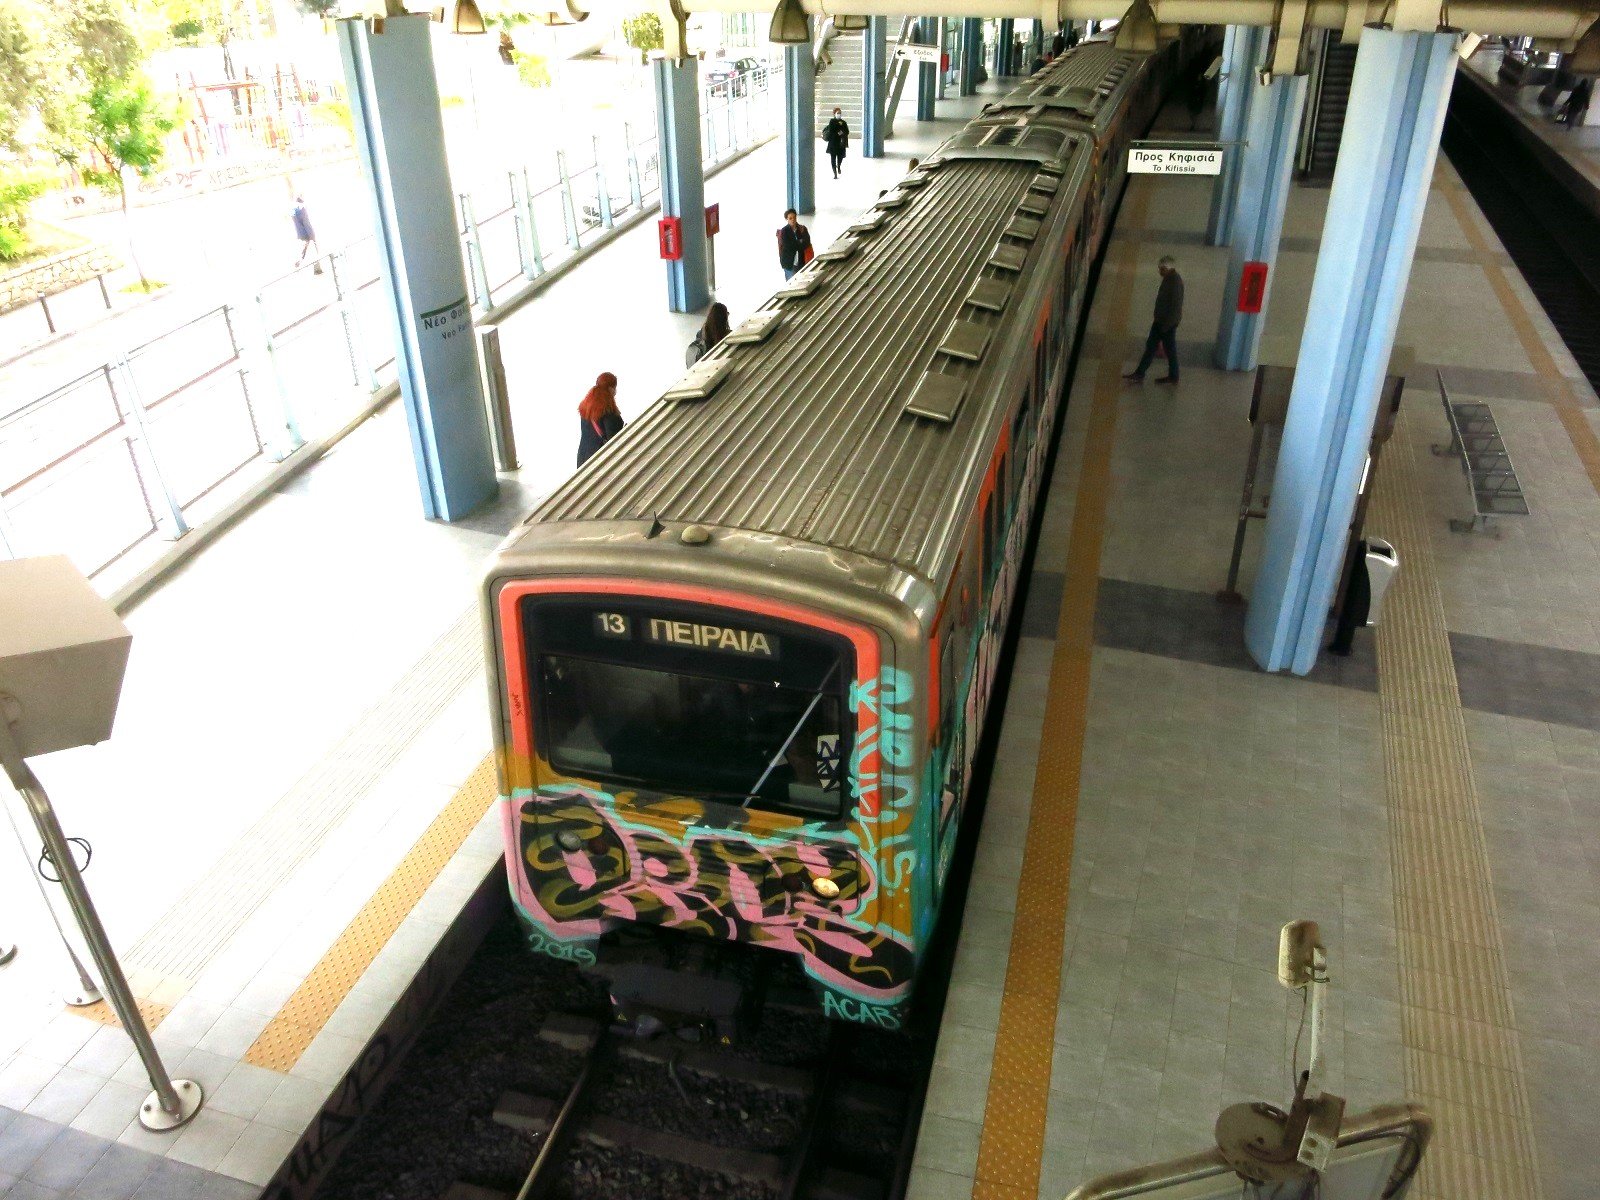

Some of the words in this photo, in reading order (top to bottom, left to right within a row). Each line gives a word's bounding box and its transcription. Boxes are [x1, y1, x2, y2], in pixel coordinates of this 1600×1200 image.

[1135, 151, 1163, 163] Προς
[1168, 152, 1215, 164] Κηφισιά
[1152, 164, 1162, 172] To
[1165, 164, 1196, 173] Kifissia
[597, 612, 626, 634] 13
[650, 618, 772, 655] ΠΕΙΡΑΙΑ
[528, 933, 597, 968] 2019
[822, 990, 901, 1030] ACAB
